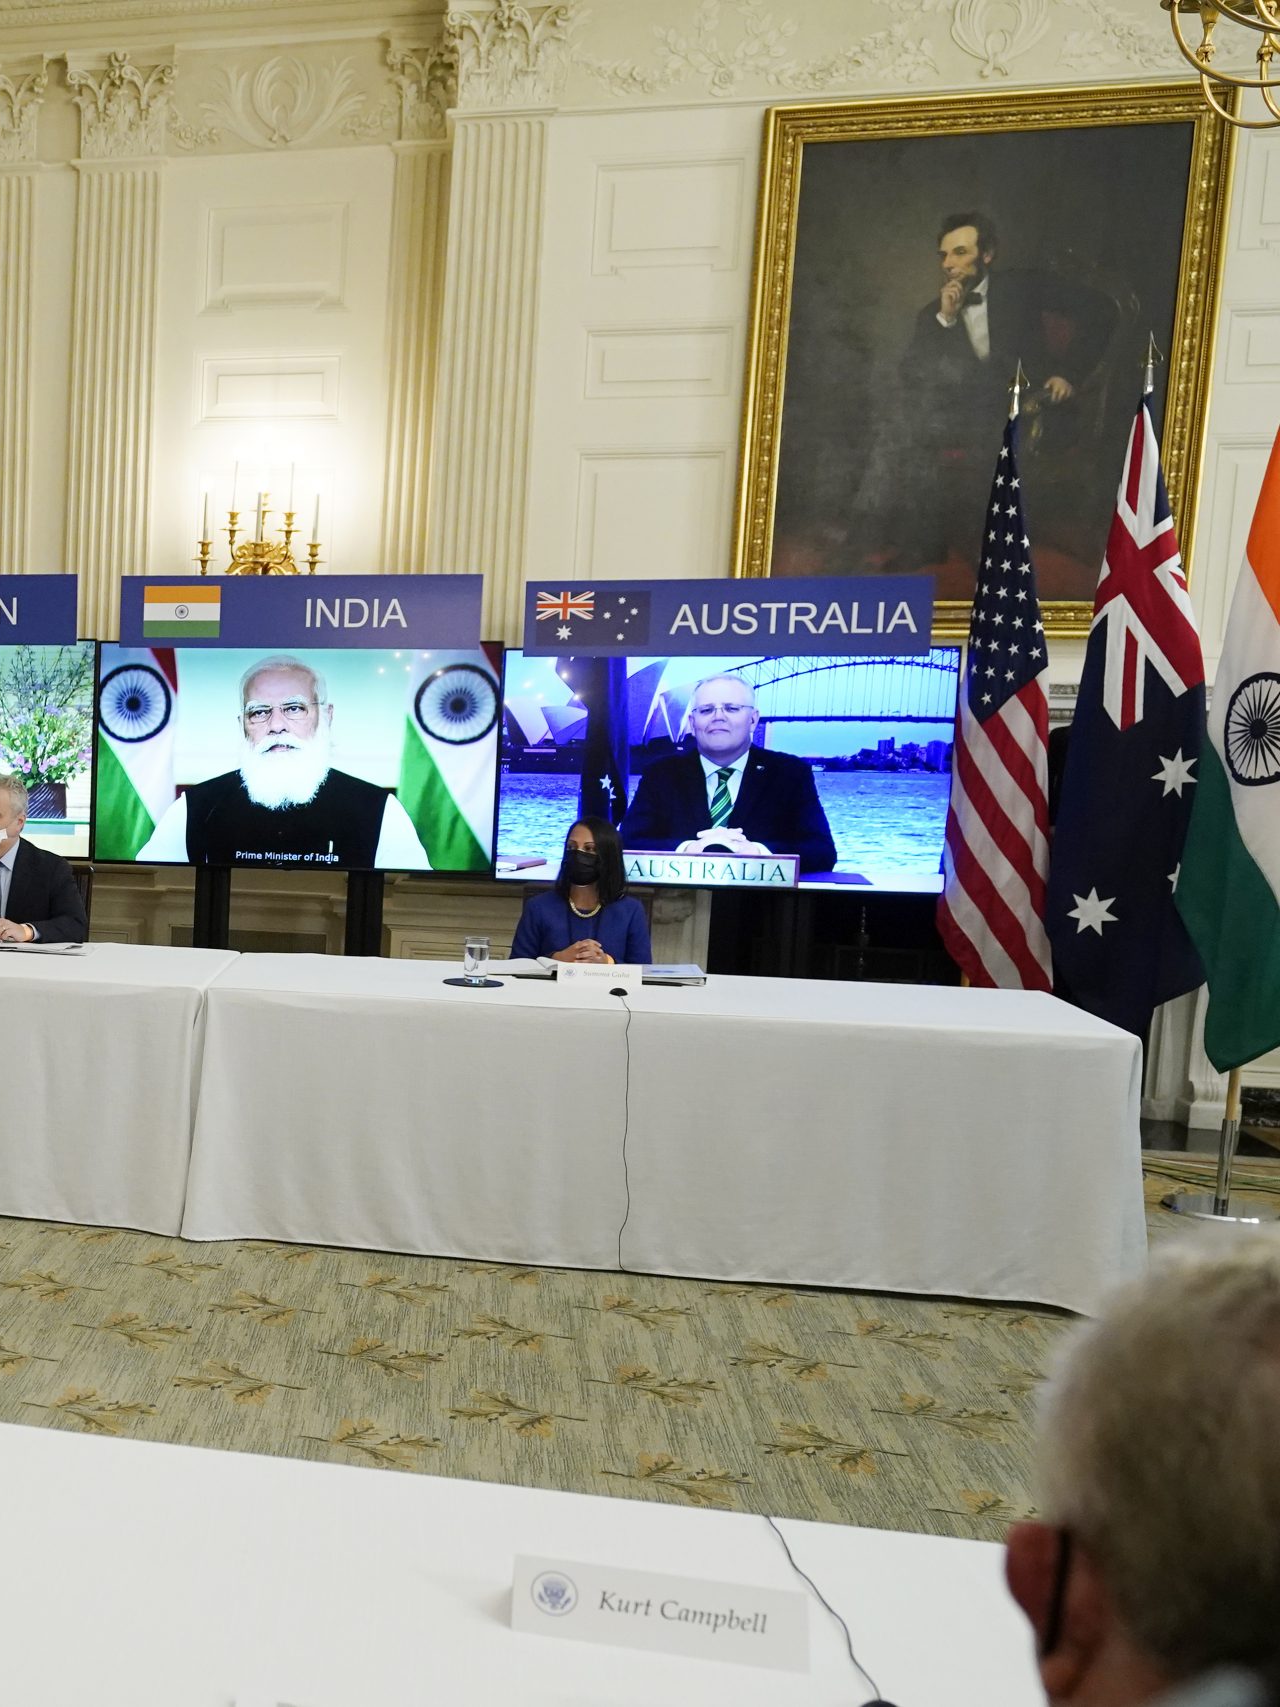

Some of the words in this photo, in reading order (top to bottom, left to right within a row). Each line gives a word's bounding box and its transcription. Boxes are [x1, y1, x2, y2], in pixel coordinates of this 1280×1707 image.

[305, 598, 408, 629] INDIA
[669, 601, 918, 635] AUSTRALIA
[235, 850, 263, 860] Prime
[264, 851, 303, 861] Minister
[304, 852, 315, 861] of
[315, 853, 339, 862] India
[628, 860, 787, 882] AUSTRALIA
[598, 1590, 652, 1616] Kurt
[659, 1599, 768, 1634] Campbell
